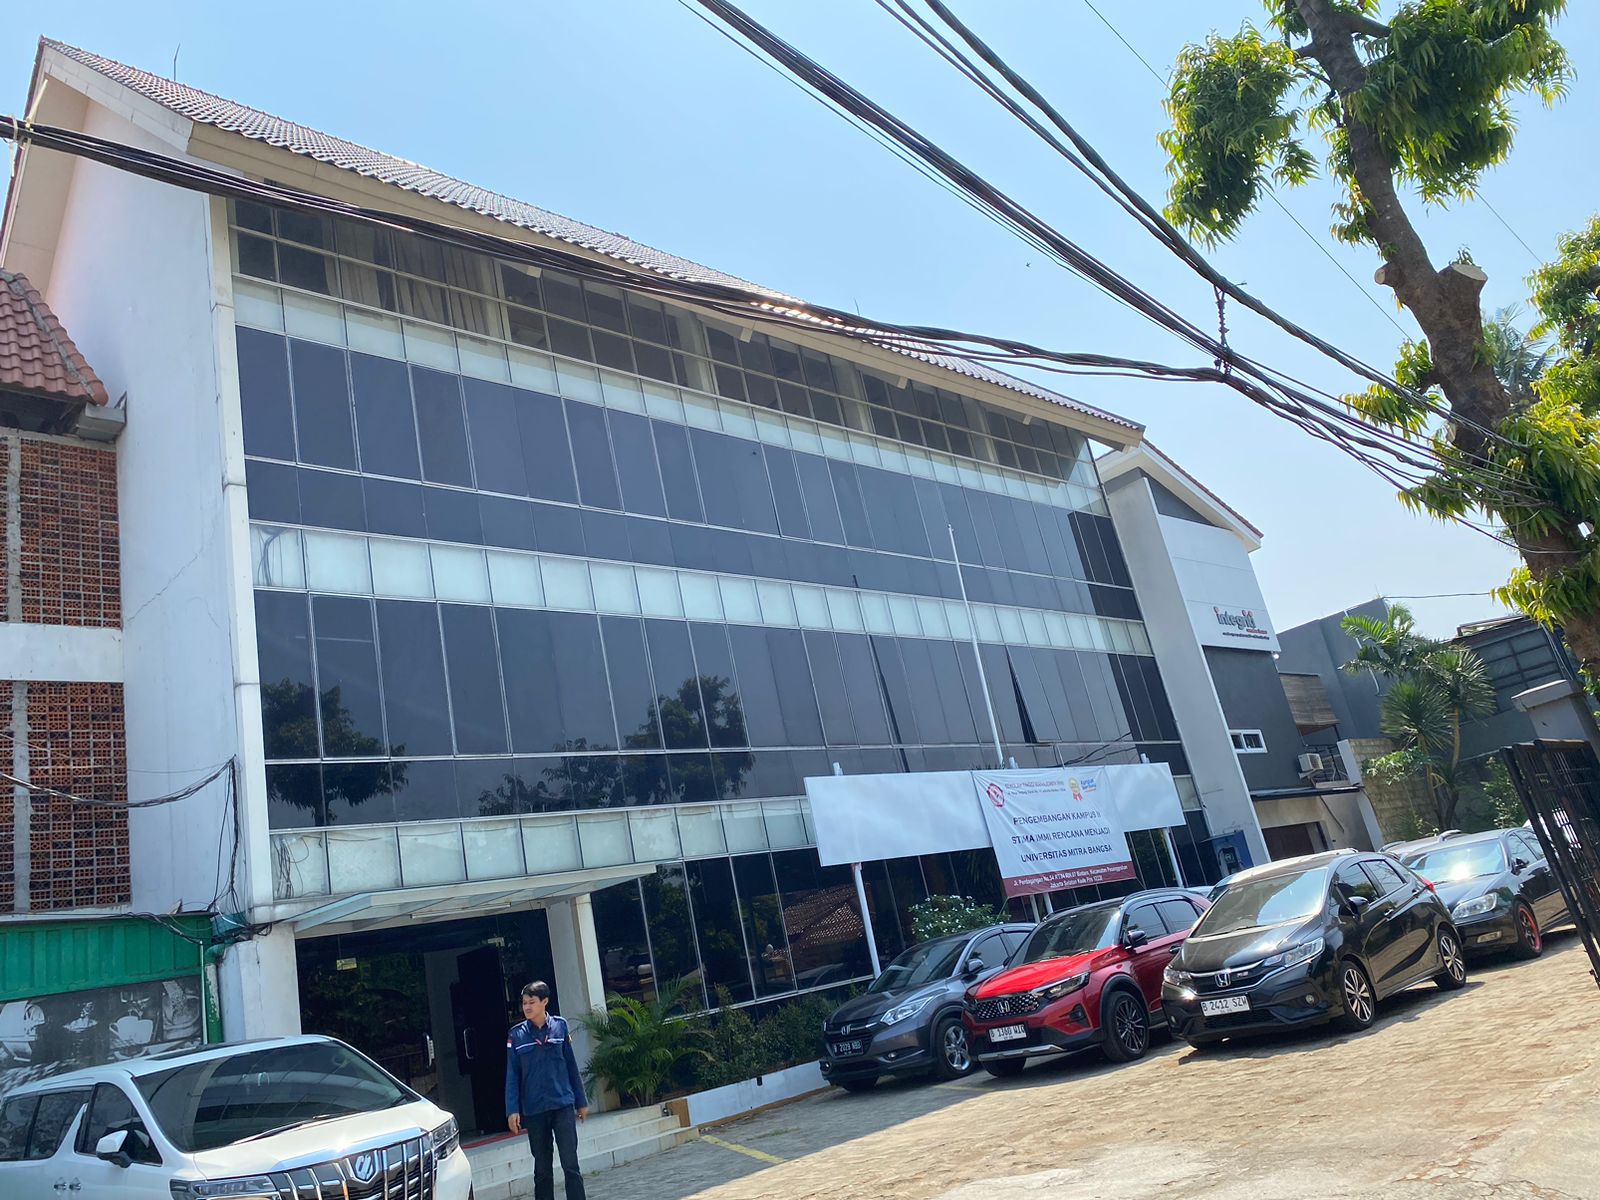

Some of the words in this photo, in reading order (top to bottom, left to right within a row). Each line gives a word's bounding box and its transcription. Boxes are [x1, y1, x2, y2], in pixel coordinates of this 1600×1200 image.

[1013, 812, 1072, 825] PENGEMBANGAN
[1072, 811, 1097, 820] KAMPUS
[1052, 829, 1085, 840] RENCANA
[1084, 827, 1111, 836] MENJADI
[1020, 849, 1068, 862] UNIVERSITAS
[1067, 847, 1087, 857] MITRA
[1088, 844, 1113, 854] BANGSA
[1202, 1002, 1208, 1012] B
[1209, 999, 1230, 1010] 2412
